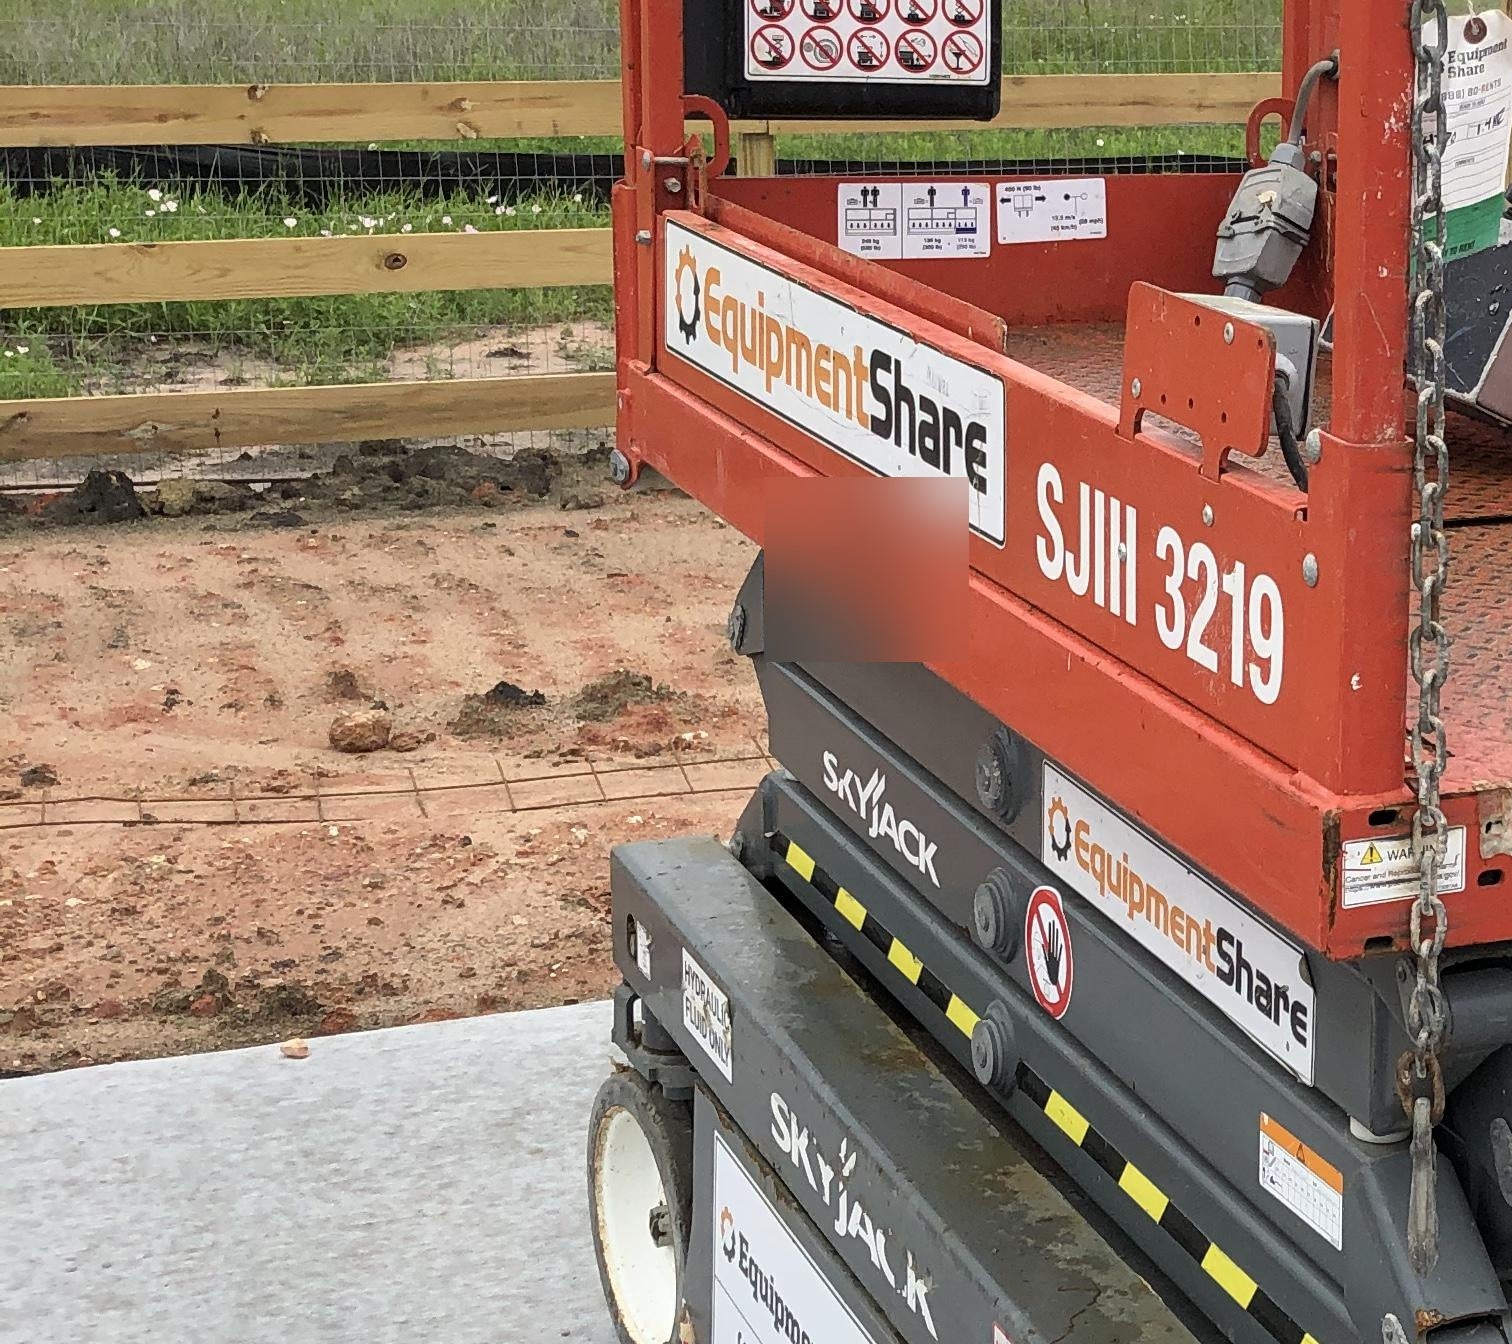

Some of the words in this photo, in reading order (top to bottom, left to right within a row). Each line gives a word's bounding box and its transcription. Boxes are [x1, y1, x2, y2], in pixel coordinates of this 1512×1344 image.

[1447, 64, 1485, 78] Share
[1448, 38, 1507, 64] Equipment
[703, 267, 988, 494] EquipmentShare
[1155, 526, 1286, 706] 3219
[823, 750, 940, 888] SKYJACK
[1346, 875, 1370, 883] Cancer
[1373, 871, 1387, 879] and
[1074, 819, 1309, 1047] EquipmentShare
[685, 996, 708, 1038] FLUID
[709, 1029, 731, 1068] ONLY
